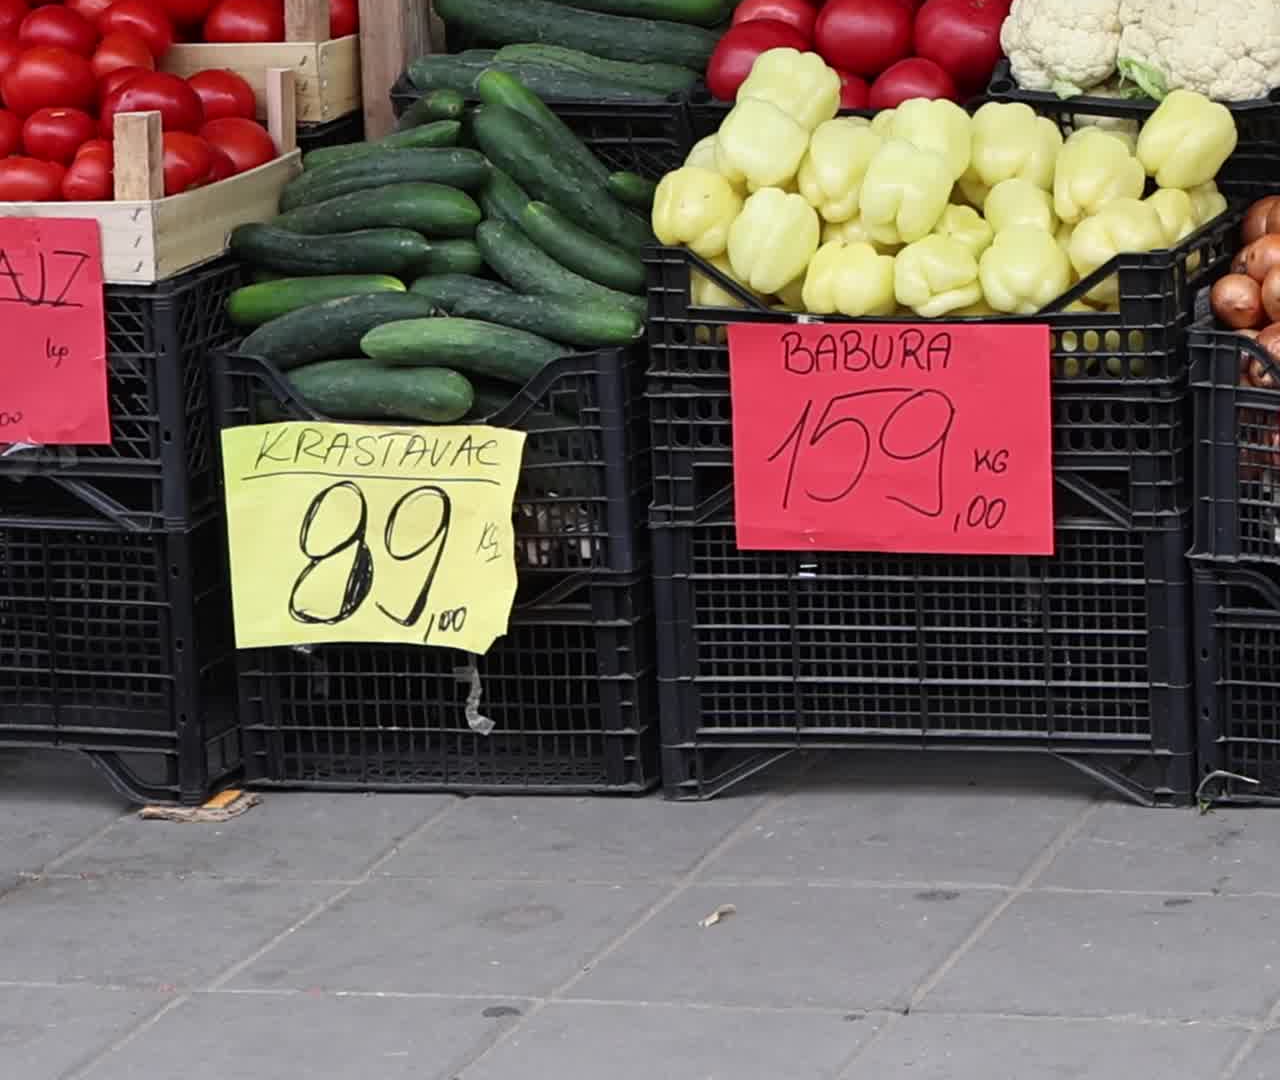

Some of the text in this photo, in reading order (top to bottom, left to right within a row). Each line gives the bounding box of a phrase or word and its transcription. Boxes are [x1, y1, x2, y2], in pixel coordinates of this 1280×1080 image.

[781, 328, 953, 376] BABURA
[255, 427, 501, 470] KRASTAVAC
[973, 449, 1009, 473] KG
